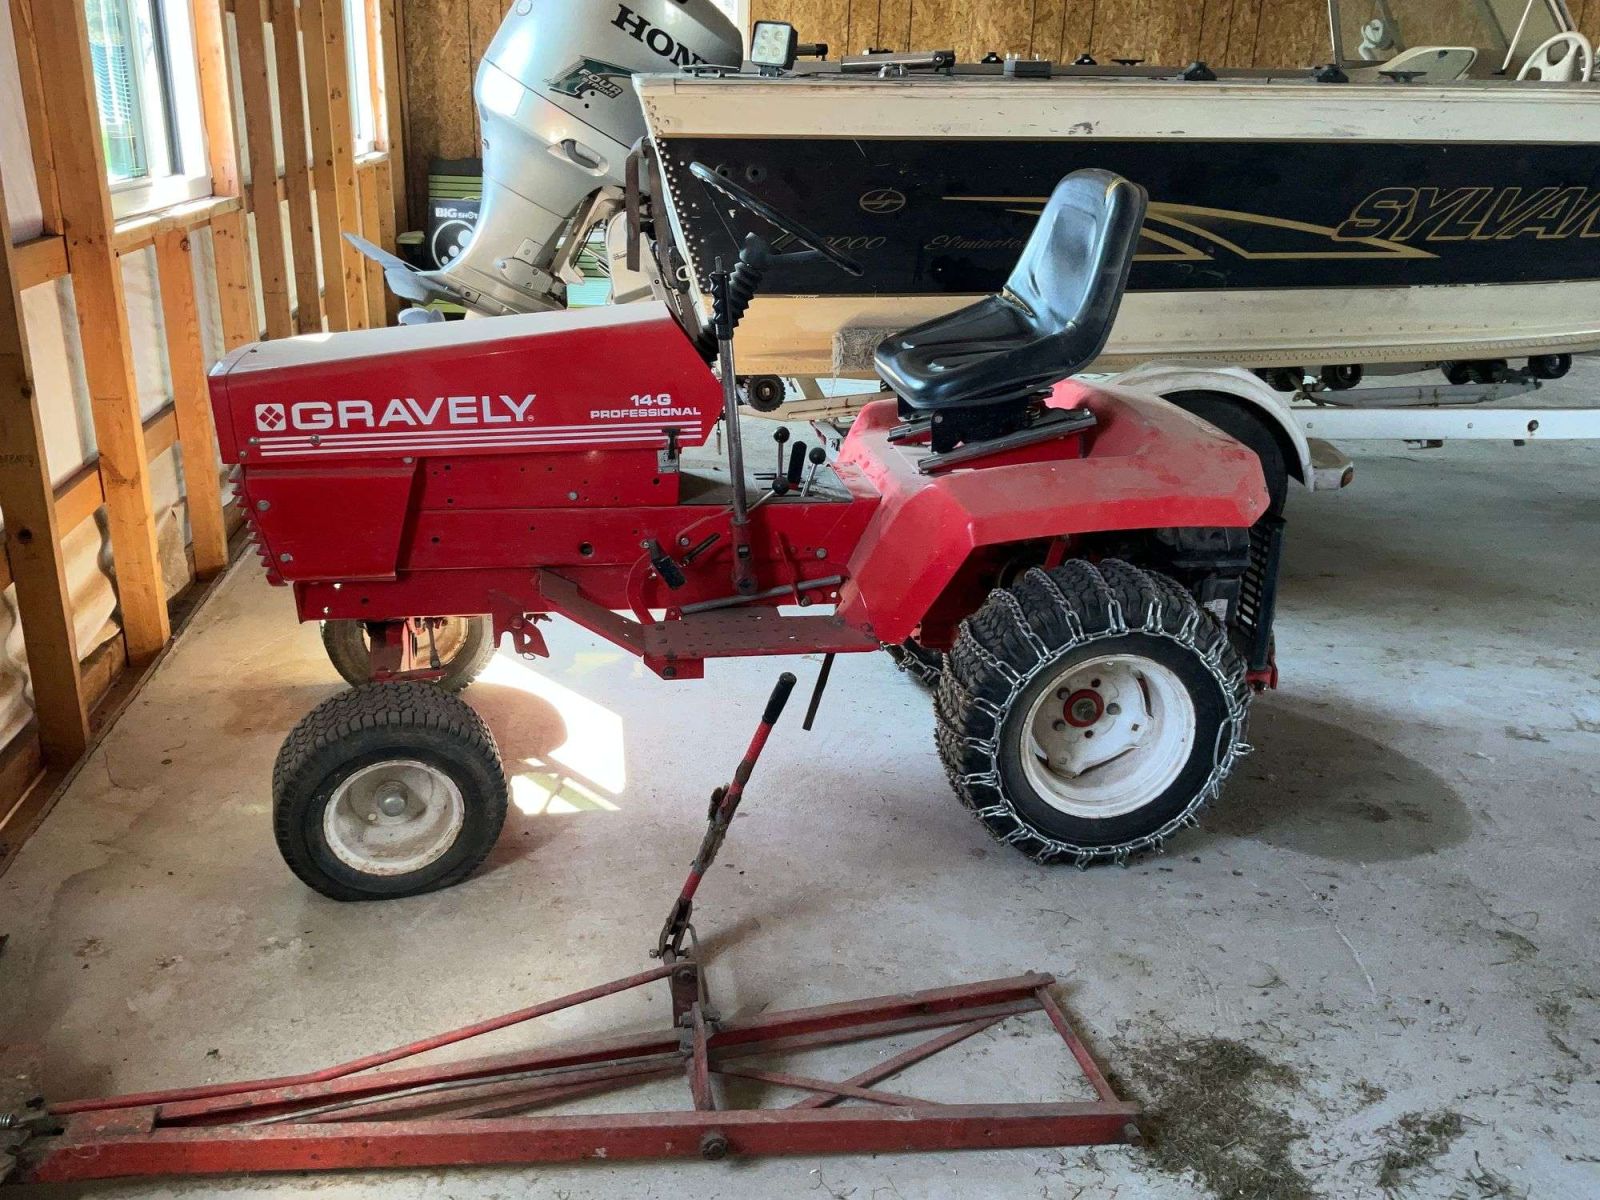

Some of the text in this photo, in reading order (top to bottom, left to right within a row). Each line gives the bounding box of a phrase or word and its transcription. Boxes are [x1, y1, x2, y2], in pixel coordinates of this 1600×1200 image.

[578, 69, 622, 95] FOUR
[435, 207, 457, 218] BIG
[292, 394, 536, 430] GRAVELY
[590, 407, 701, 419] PROFESSIONAL
